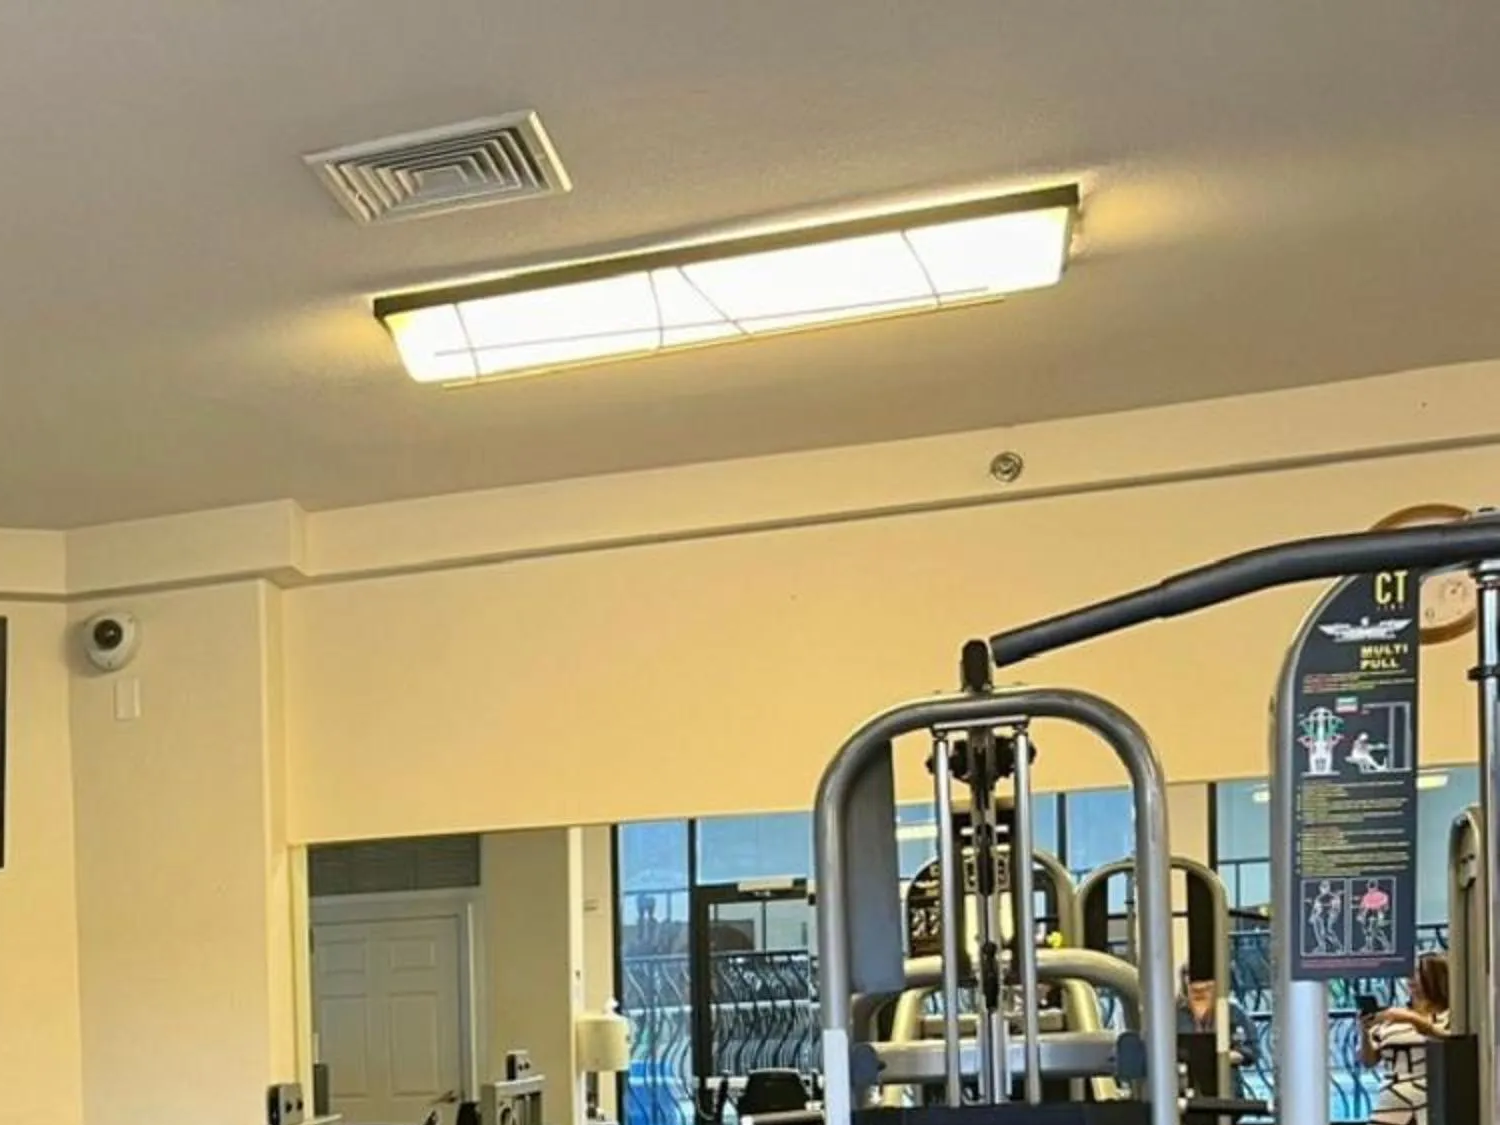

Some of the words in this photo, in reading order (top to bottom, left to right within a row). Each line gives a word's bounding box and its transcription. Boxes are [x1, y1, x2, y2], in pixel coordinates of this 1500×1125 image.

[1374, 570, 1409, 604] CT
[1360, 643, 1409, 659] MULTI
[1359, 657, 1399, 671] PULL
